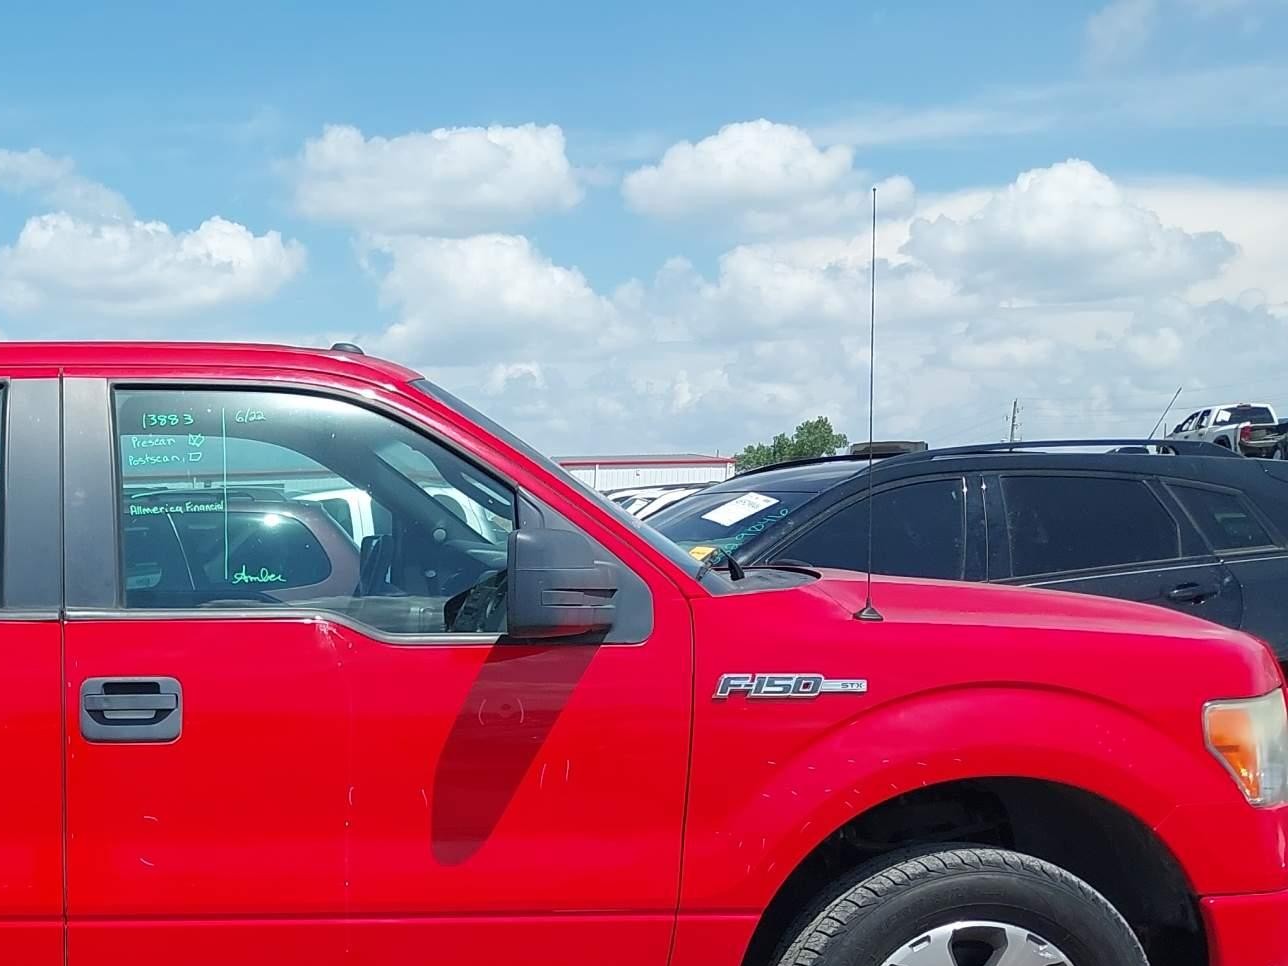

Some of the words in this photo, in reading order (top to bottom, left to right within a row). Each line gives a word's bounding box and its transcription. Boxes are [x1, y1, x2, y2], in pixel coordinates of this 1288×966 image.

[142, 412, 194, 428] 13883
[235, 408, 266, 423] 6/22
[131, 436, 176, 448] Prescan
[185, 500, 224, 512] Financial
[714, 673, 824, 697] F-150
